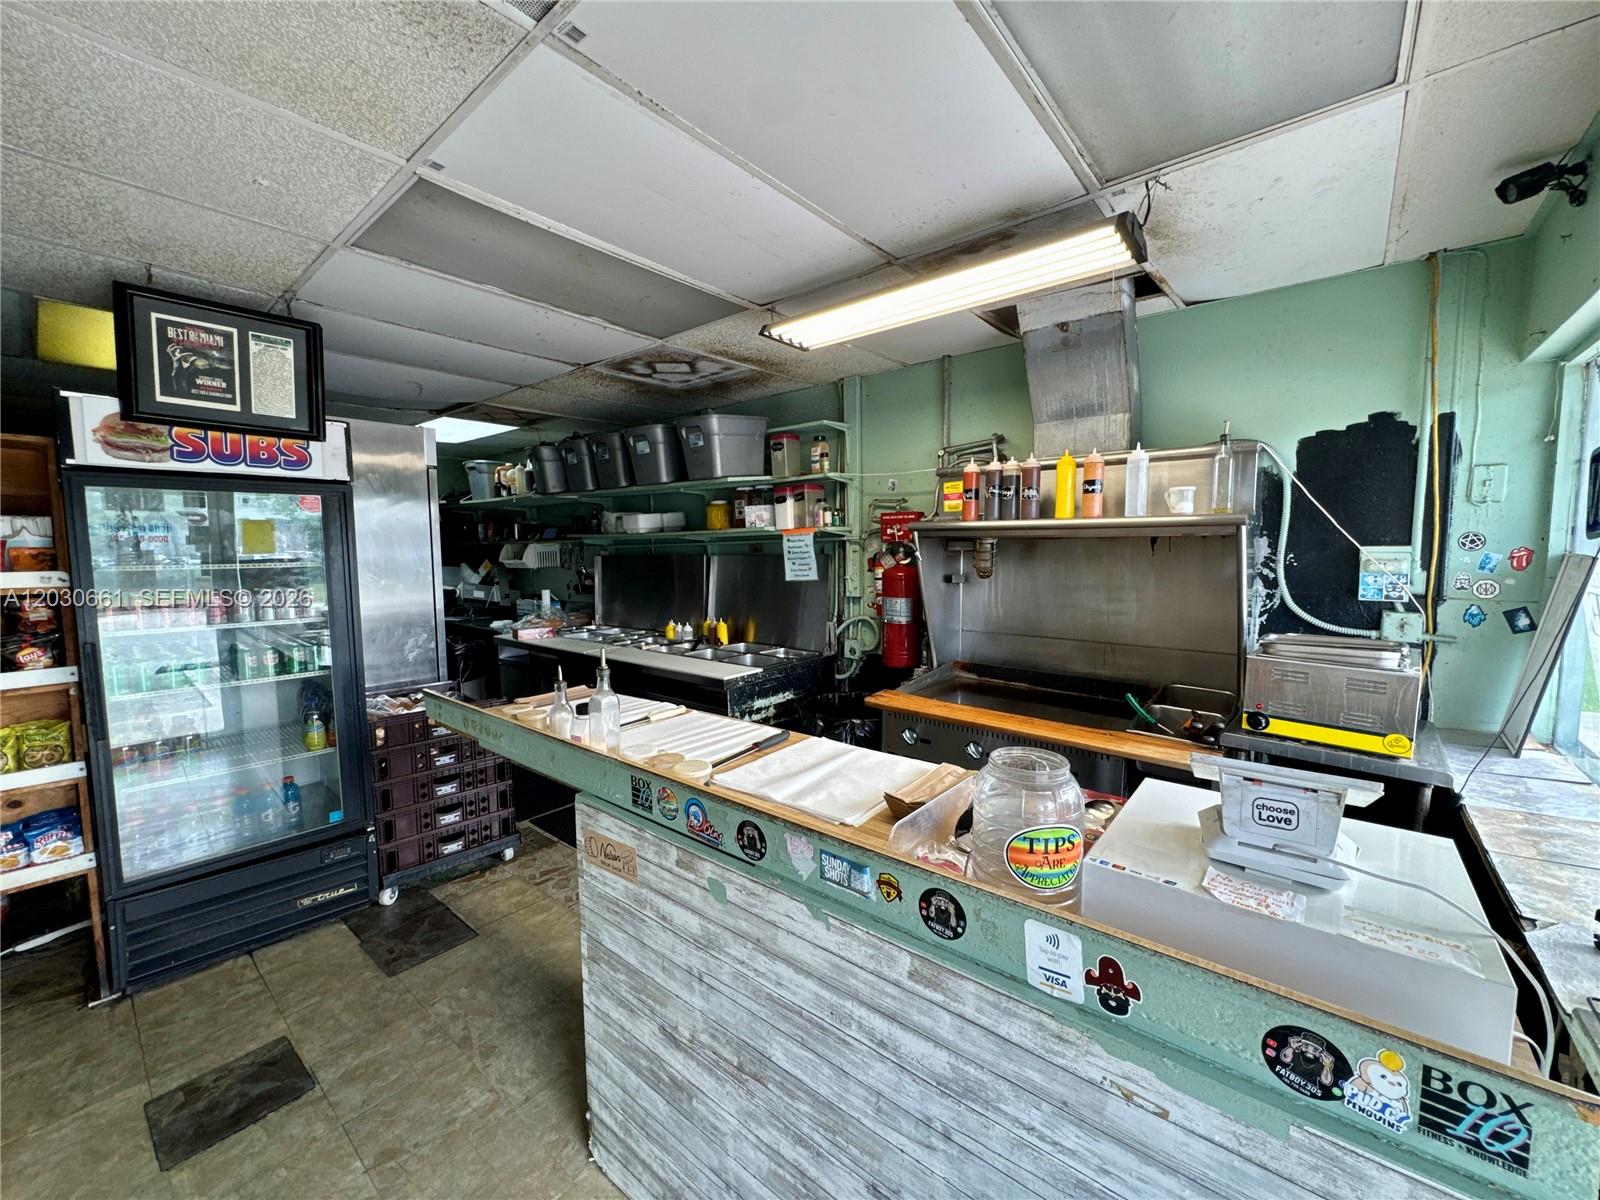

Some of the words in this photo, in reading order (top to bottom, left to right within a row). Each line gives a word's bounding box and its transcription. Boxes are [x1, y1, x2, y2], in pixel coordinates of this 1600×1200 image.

[167, 326, 188, 340] BEST
[200, 332, 224, 348] MIAMI
[195, 377, 227, 388] WINNER
[169, 425, 312, 470] SUBS
[631, 774, 651, 791] BOX
[1255, 803, 1296, 816] choose
[1258, 811, 1292, 825] Love
[1023, 833, 1077, 855] TIPS
[821, 853, 851, 875] SUNDAY
[824, 866, 849, 887] SHOTS
[1042, 972, 1068, 989] VISA
[1275, 1065, 1323, 1097] FATBOY.305
[1420, 1063, 1535, 1129] BOX
[1346, 1099, 1402, 1133] PENGUINS
[1417, 1125, 1456, 1148] FITNESS
[1465, 1146, 1529, 1179] KNOWLEDGE
